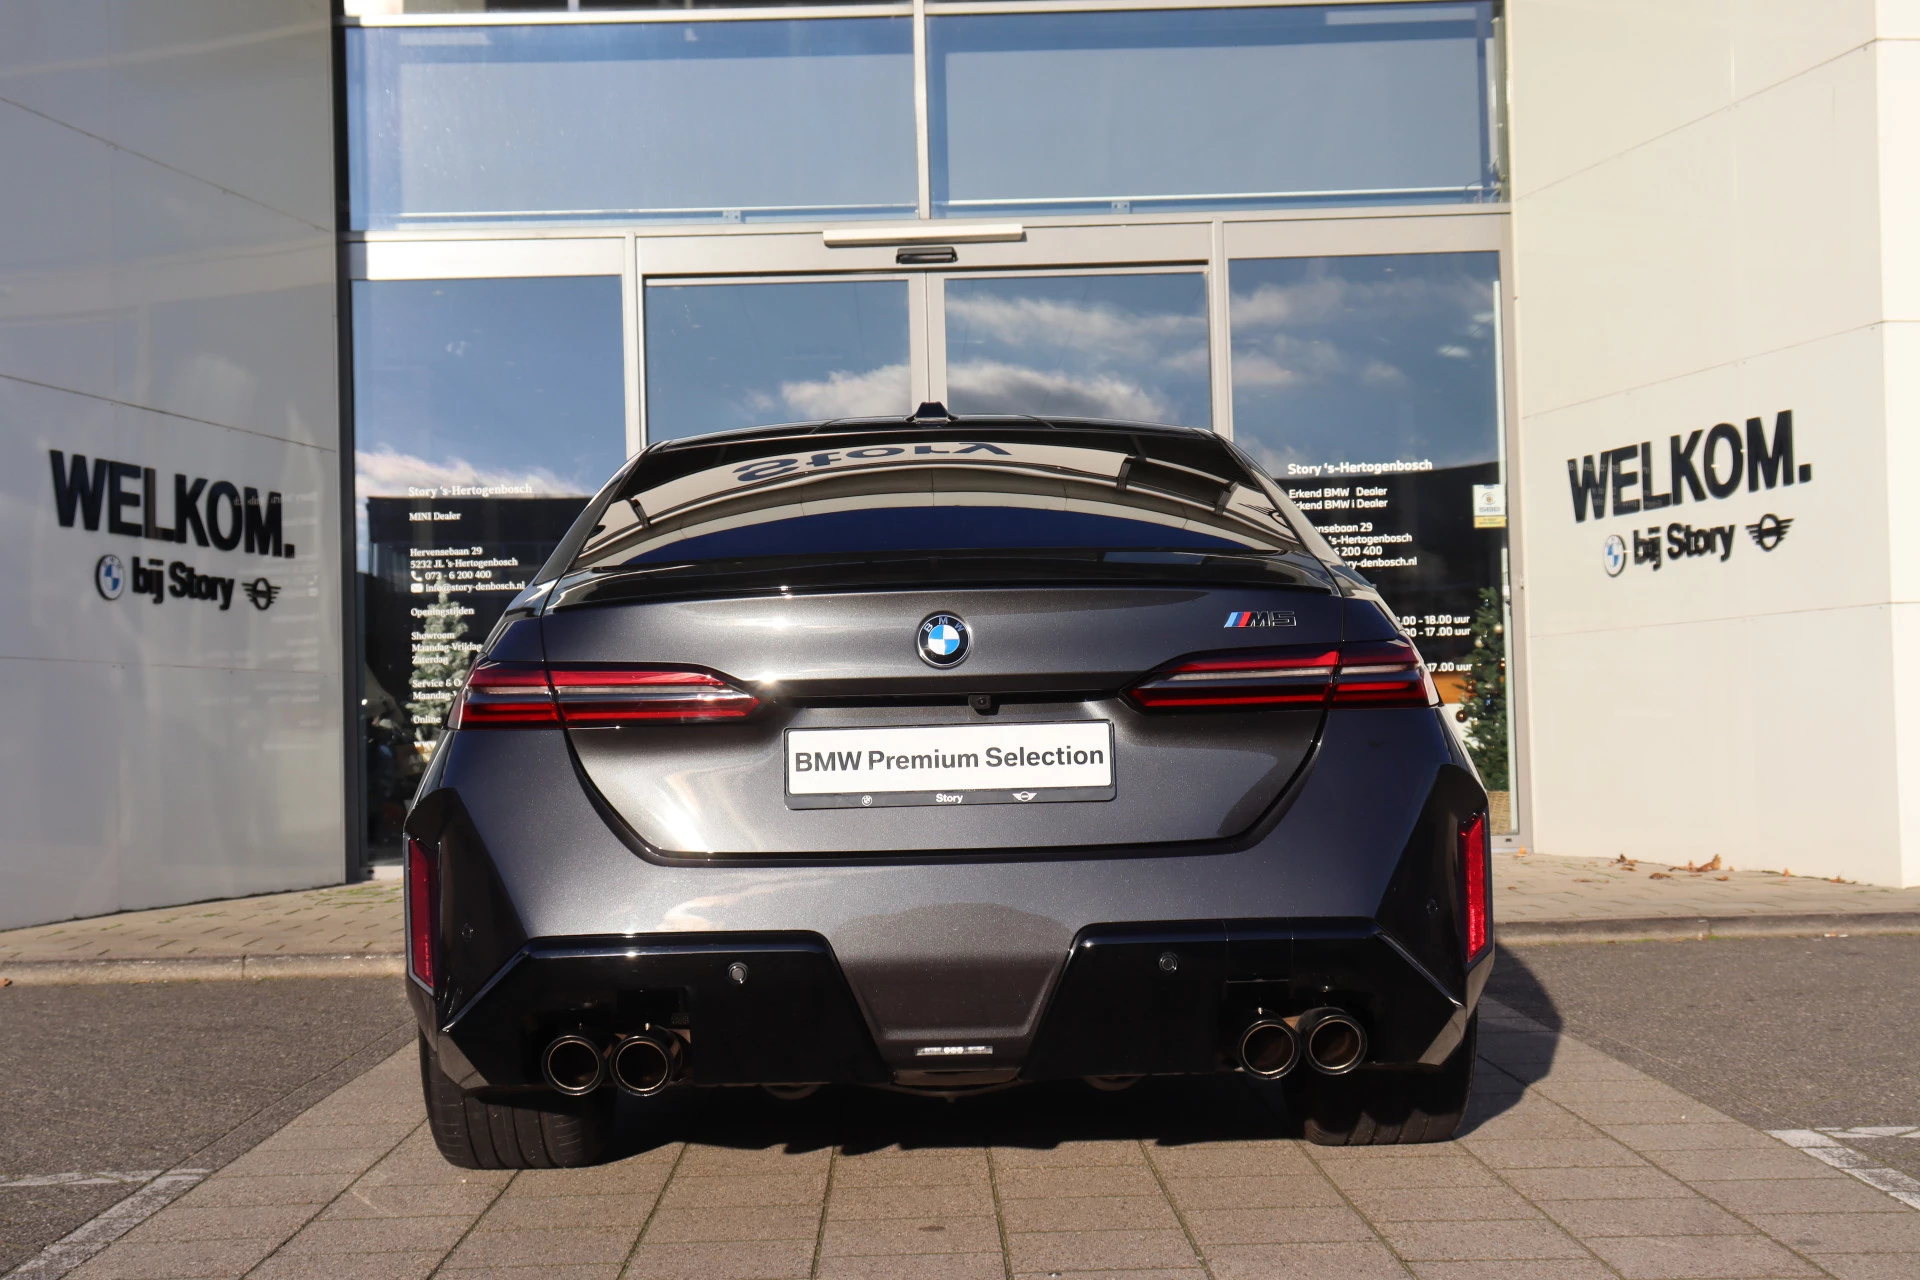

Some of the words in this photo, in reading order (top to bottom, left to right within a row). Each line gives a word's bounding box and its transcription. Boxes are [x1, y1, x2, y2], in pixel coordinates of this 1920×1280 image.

[1287, 463, 1322, 477] Story
[1567, 409, 1812, 523] WELKOM.
[408, 486, 437, 499] Story
[1288, 488, 1322, 499] Erkend
[1323, 487, 1350, 498] BMW
[1355, 487, 1388, 497] Dealer
[50, 449, 295, 559] WELKOM.
[1293, 500, 1323, 511] rkend
[1324, 500, 1350, 510] BMW
[1351, 500, 1356, 509] i
[1356, 499, 1389, 509] Dealer
[409, 512, 432, 521] MINI
[433, 511, 462, 520] Dealer
[1360, 522, 1373, 532] 29
[410, 547, 470, 557] Hervensebaan
[471, 547, 483, 556] 29
[1341, 546, 1361, 556] 200
[1362, 545, 1383, 556] 400
[1632, 526, 1662, 572] bij
[1667, 522, 1736, 563] Story
[410, 560, 432, 569] 5232
[433, 560, 445, 569] JL
[425, 571, 442, 580] 073
[448, 571, 455, 580] 6
[457, 570, 474, 579] 200
[475, 570, 492, 579] 400
[132, 556, 164, 604] bij
[168, 561, 235, 611] Story
[425, 581, 526, 593] info@story-denbosch.nl
[411, 606, 475, 618] Openingstijden
[1248, 611, 1297, 627] M5
[1424, 614, 1453, 625] 18.00
[1453, 615, 1471, 624] uur
[411, 631, 456, 641] Showroom
[1454, 627, 1472, 636] uur
[412, 655, 449, 666] Zaterdag
[1455, 663, 1473, 671] uur
[412, 679, 444, 688] Service
[445, 679, 452, 687] &
[413, 714, 442, 724] Online
[795, 751, 862, 772] BMW
[869, 748, 979, 771] Premium
[985, 745, 1104, 768] Selection
[935, 793, 964, 804] Story
